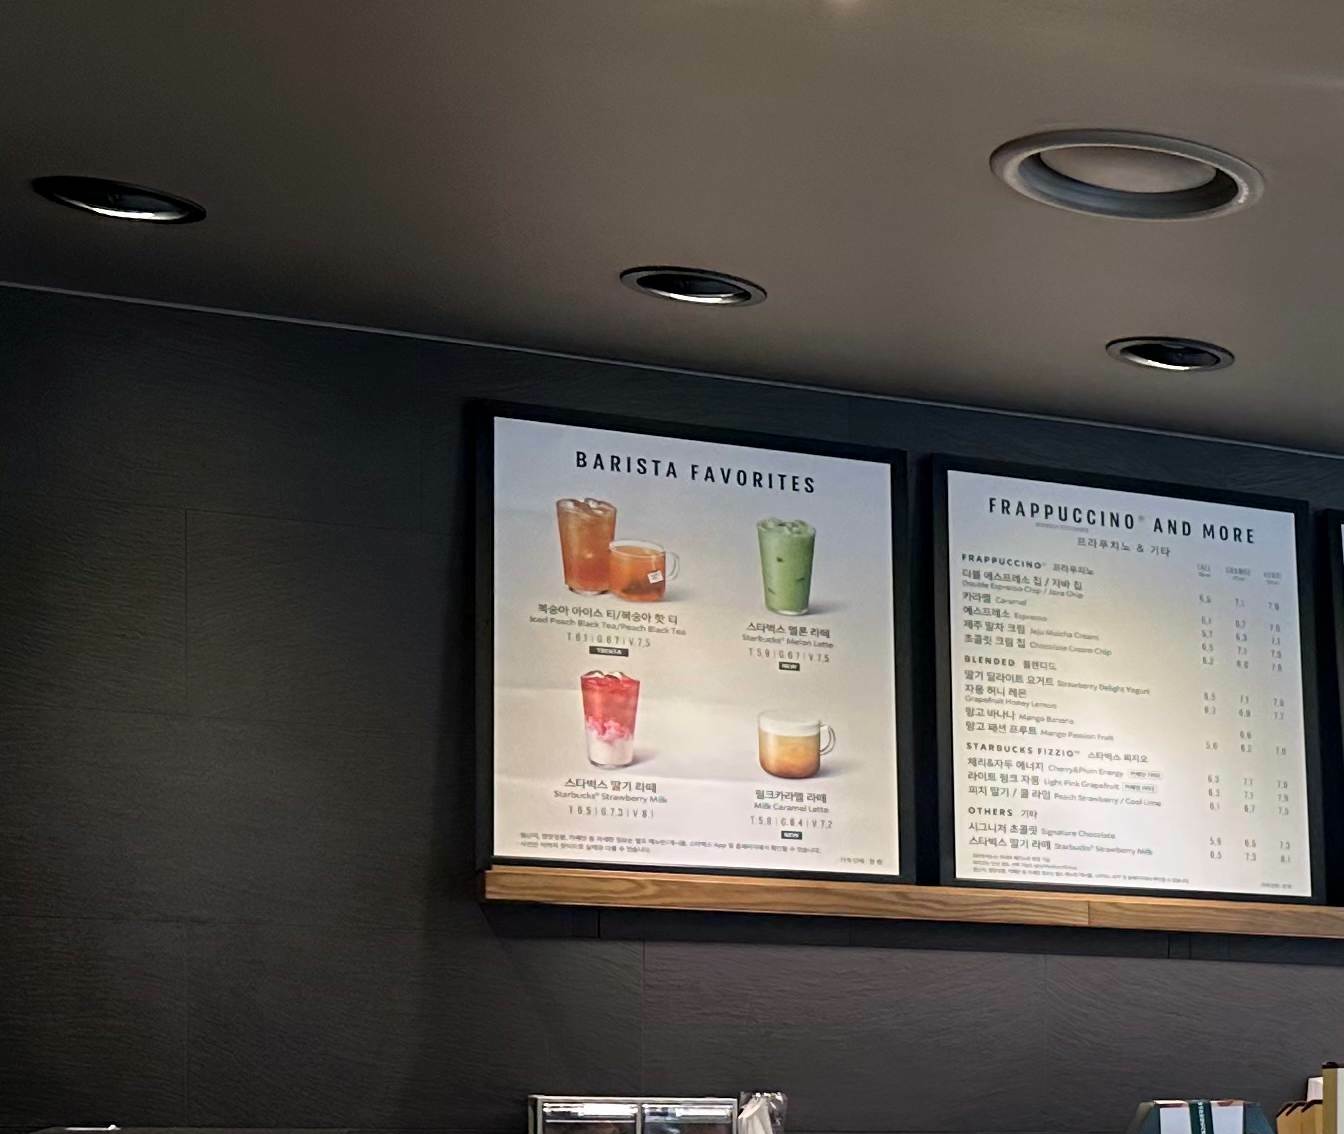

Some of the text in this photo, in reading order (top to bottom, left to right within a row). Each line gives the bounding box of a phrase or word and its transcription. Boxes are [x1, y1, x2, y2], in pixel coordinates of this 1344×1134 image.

[576, 451, 815, 493] BARISTA FAVORITES
[1153, 517, 1192, 536] AND
[1202, 523, 1256, 544] MORE
[1077, 536, 1131, 552] 프라푸치노
[1150, 545, 1171, 557] 기타
[572, 606, 603, 618] 아이스
[746, 622, 785, 634] 스타벅스
[964, 655, 1016, 667] BLENDED
[966, 742, 1033, 755] STARBUCKS
[564, 778, 608, 790] 스타벅스
[968, 807, 1013, 817] OTHERS
